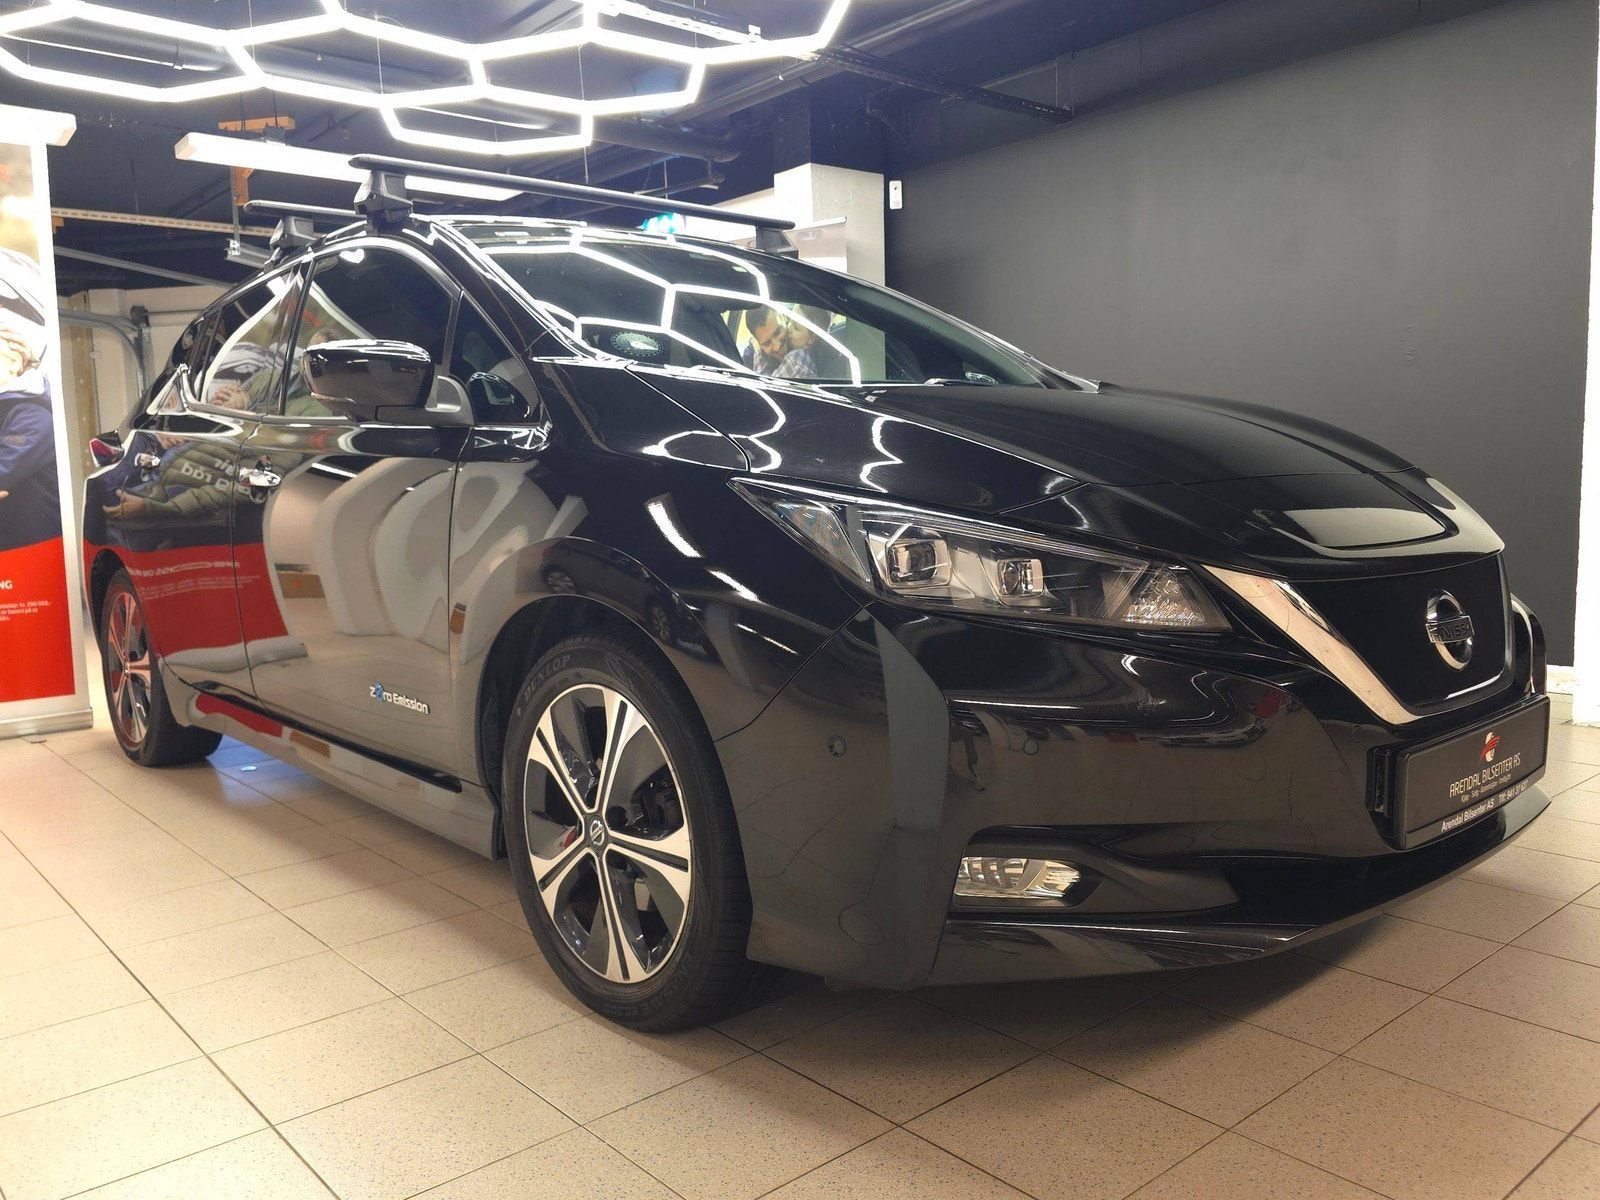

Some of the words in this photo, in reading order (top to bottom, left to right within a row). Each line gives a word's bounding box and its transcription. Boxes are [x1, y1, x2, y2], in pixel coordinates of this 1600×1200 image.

[524, 654, 571, 701] DUNLOP
[393, 693, 429, 715] Emission
[1449, 772, 1481, 798] ARENDAL
[1481, 756, 1513, 783] BILSENTER
[1513, 752, 1521, 768] AS
[1441, 813, 1464, 832] Arendal
[1464, 804, 1487, 822] Bilsenter
[1486, 799, 1495, 810] AS
